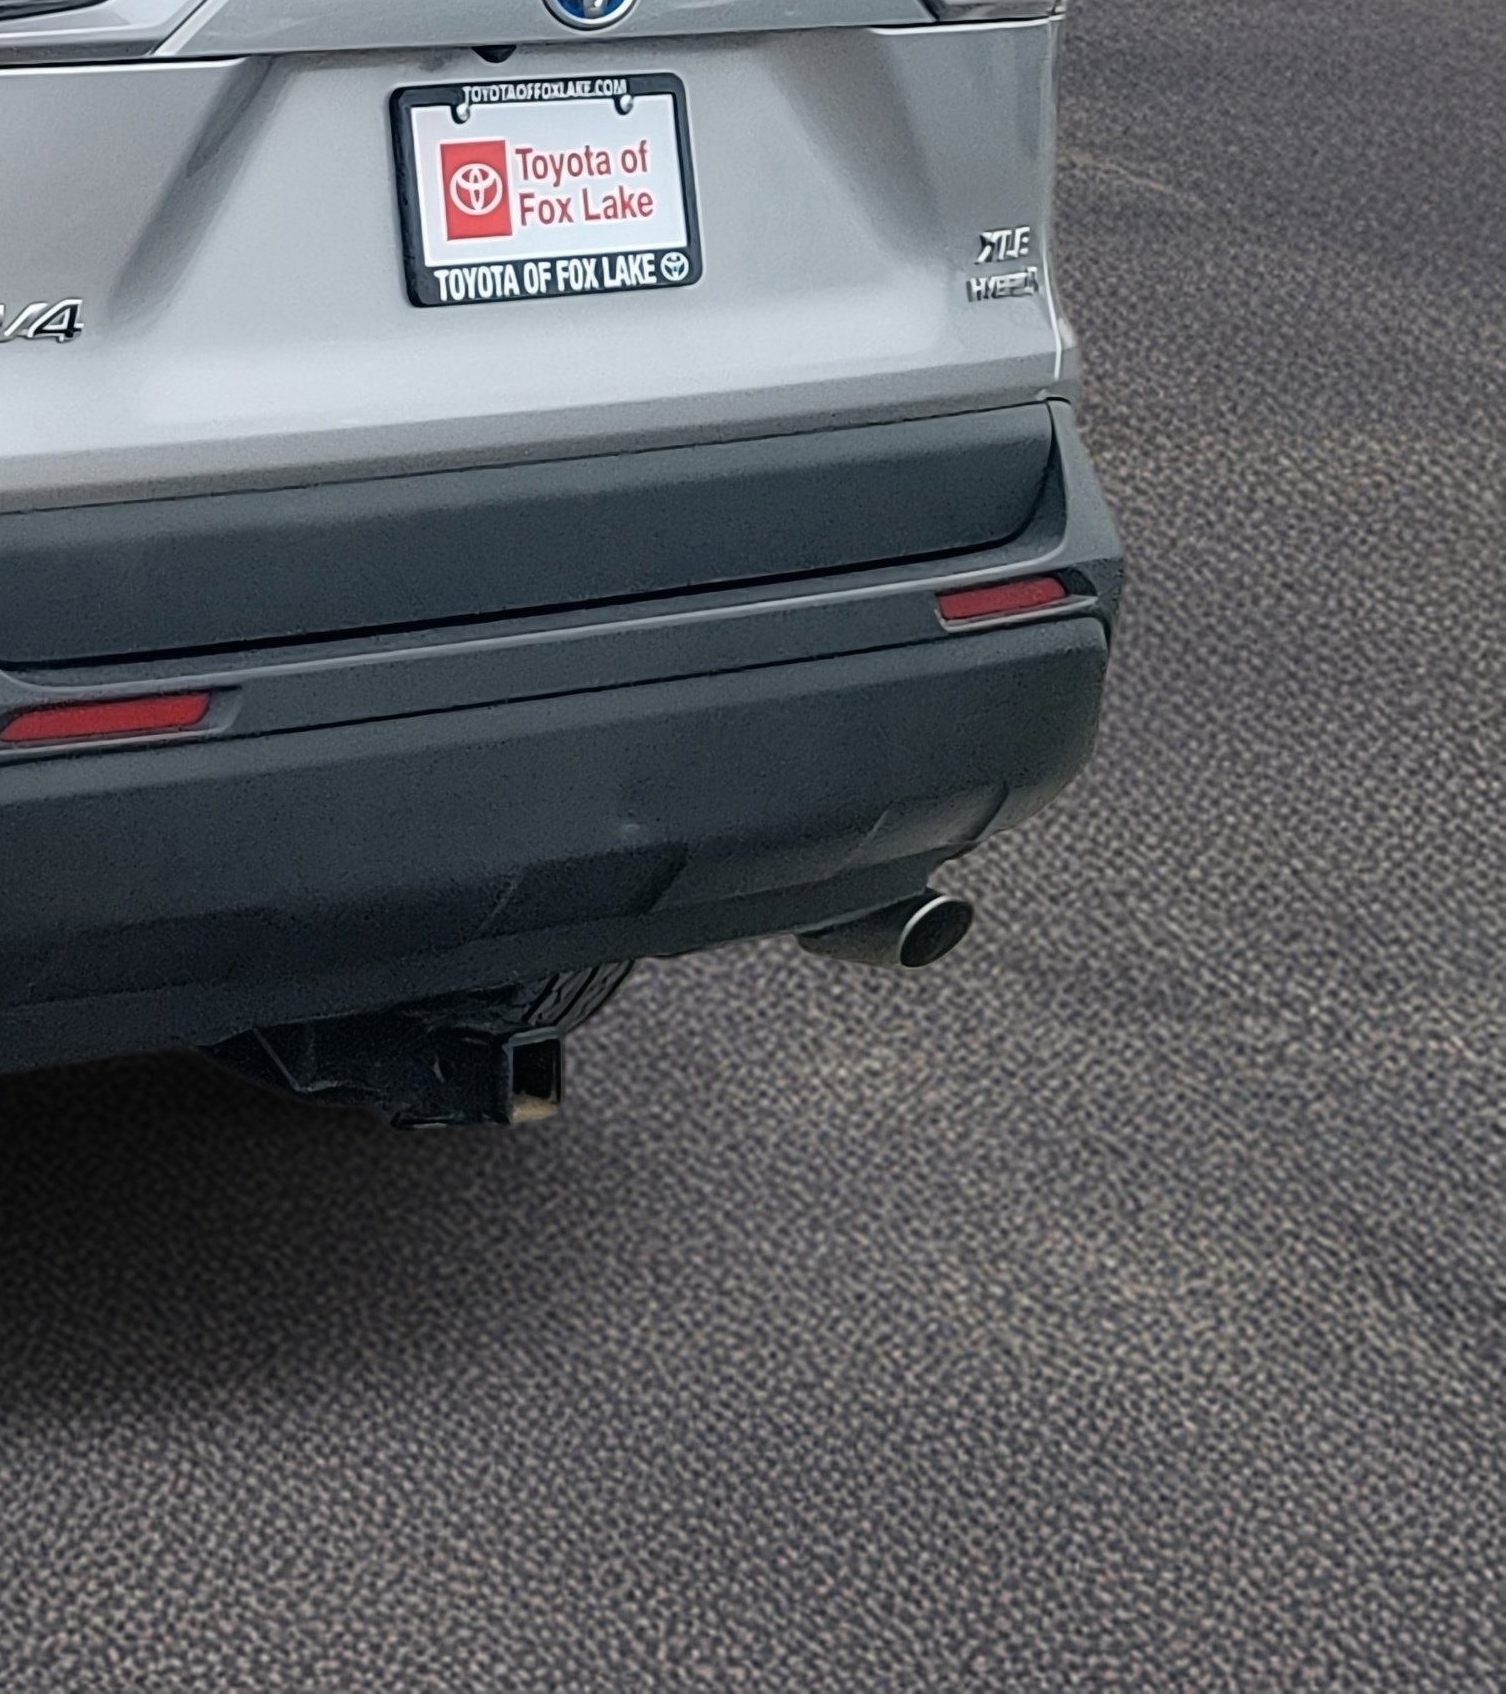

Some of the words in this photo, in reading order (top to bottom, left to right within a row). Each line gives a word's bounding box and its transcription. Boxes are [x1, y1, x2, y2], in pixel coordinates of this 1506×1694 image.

[515, 145, 611, 187] Toyota
[621, 140, 649, 173] of
[519, 190, 573, 227] Fox
[582, 185, 655, 222] Lake
[433, 264, 520, 302] TOYOTA
[523, 261, 551, 295] OF
[556, 257, 600, 292] FOX
[602, 252, 658, 289] LAKE
